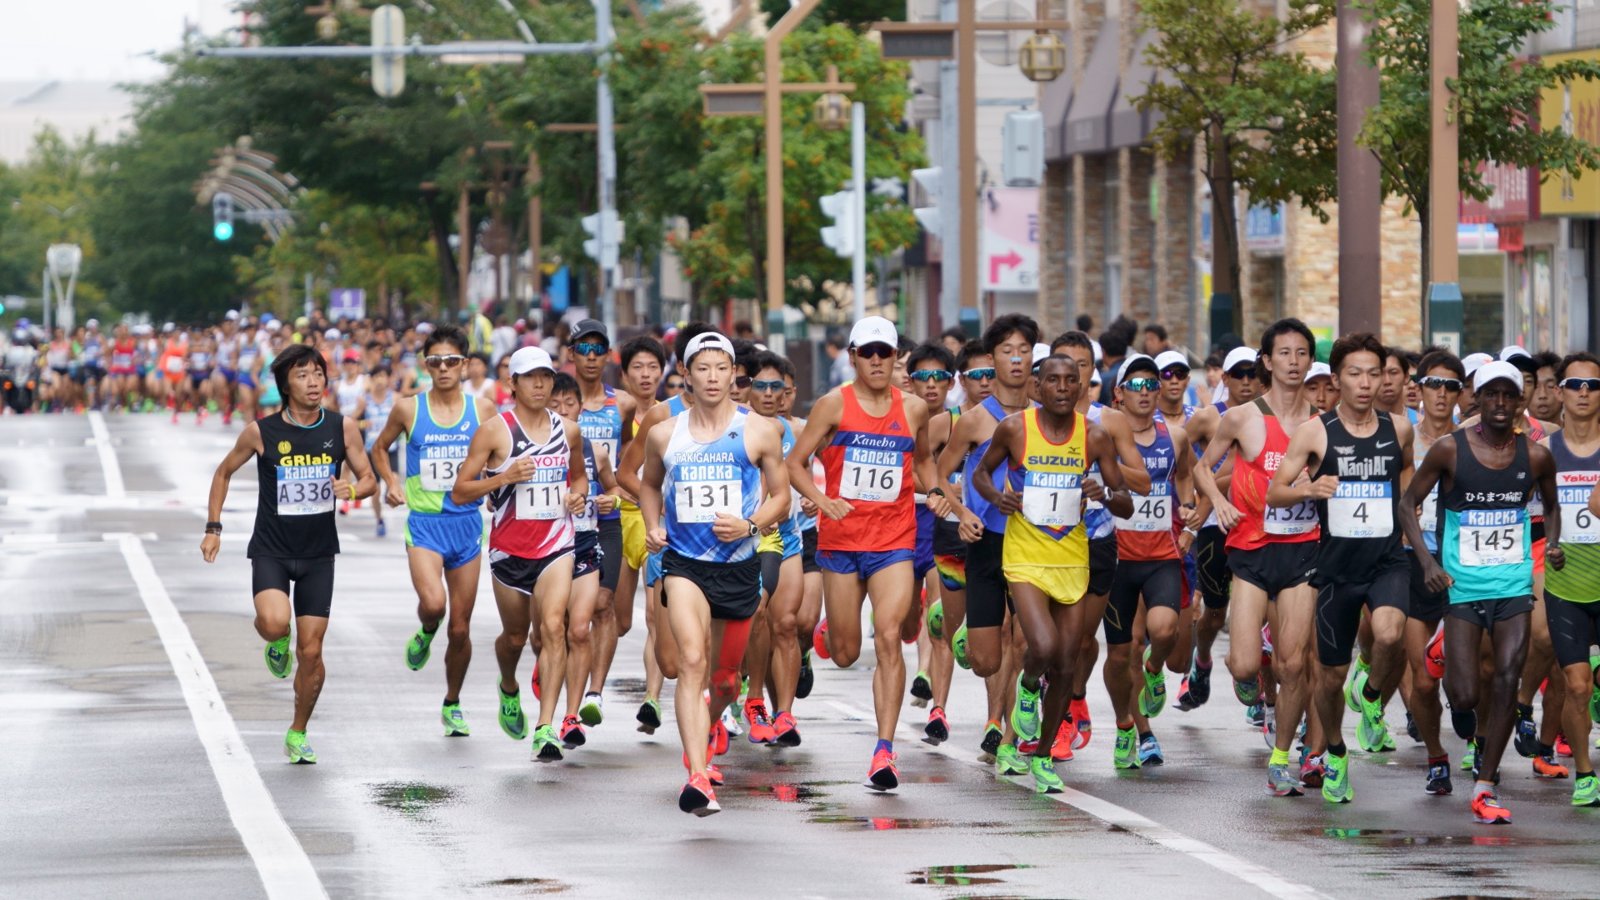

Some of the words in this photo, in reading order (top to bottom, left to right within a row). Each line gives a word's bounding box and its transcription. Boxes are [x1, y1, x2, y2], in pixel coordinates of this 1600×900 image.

[852, 434, 896, 448] Kanebo
[534, 457, 567, 467] YOTA
[675, 452, 734, 463] TAKIGAHARA
[1028, 456, 1084, 468] SUZUKI
[1337, 456, 1394, 480] NanjiAC
[852, 466, 894, 489] 116
[526, 486, 560, 507] 111
[684, 484, 729, 508] 131
[1049, 492, 1059, 512] 1
[1352, 502, 1369, 523] 4
[1576, 507, 1591, 529] 6
[1471, 529, 1515, 551] 145
